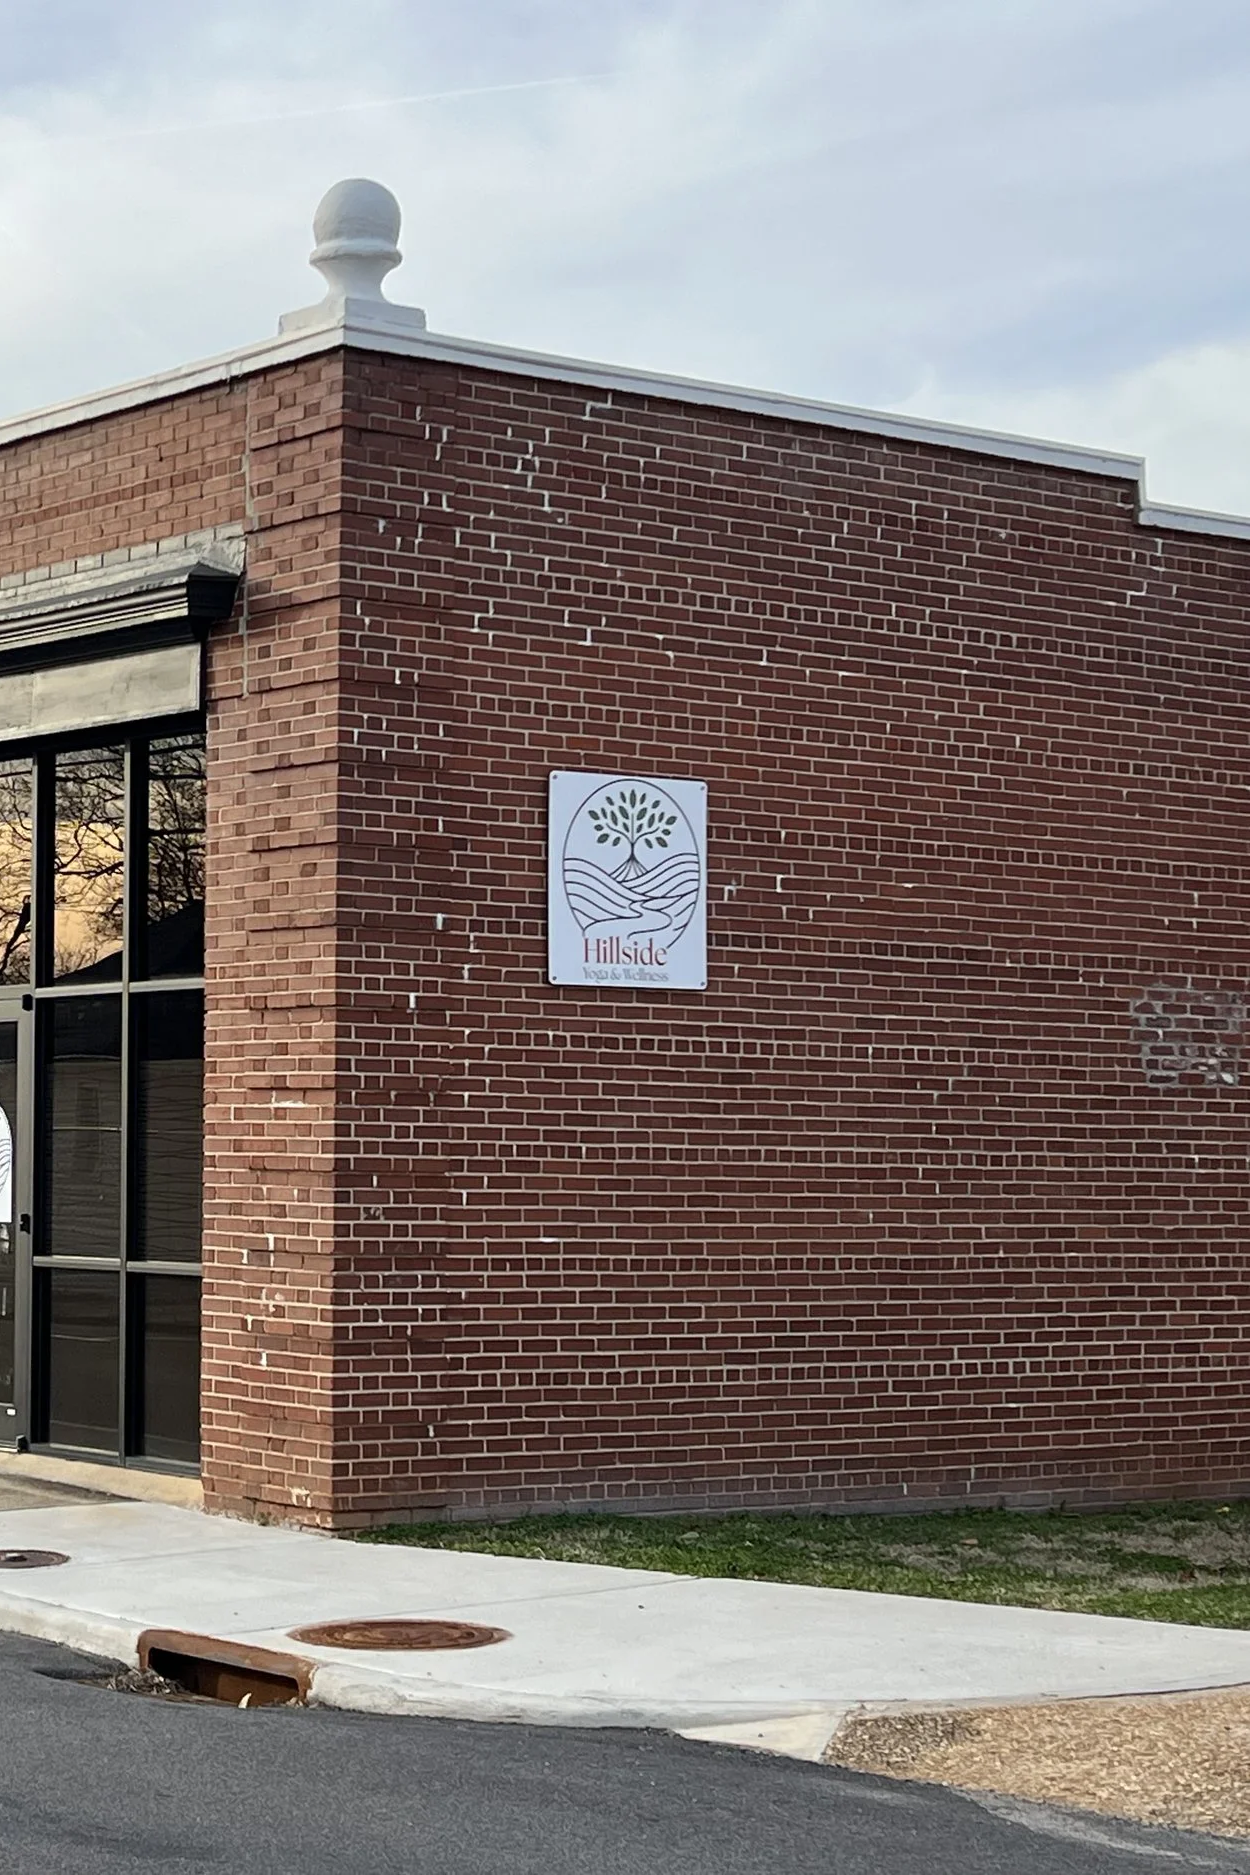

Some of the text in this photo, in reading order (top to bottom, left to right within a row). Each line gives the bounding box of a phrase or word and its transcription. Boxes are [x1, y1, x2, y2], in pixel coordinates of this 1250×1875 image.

[583, 936, 667, 966] Hillside
[582, 966, 669, 984] Yoga & Wellness
